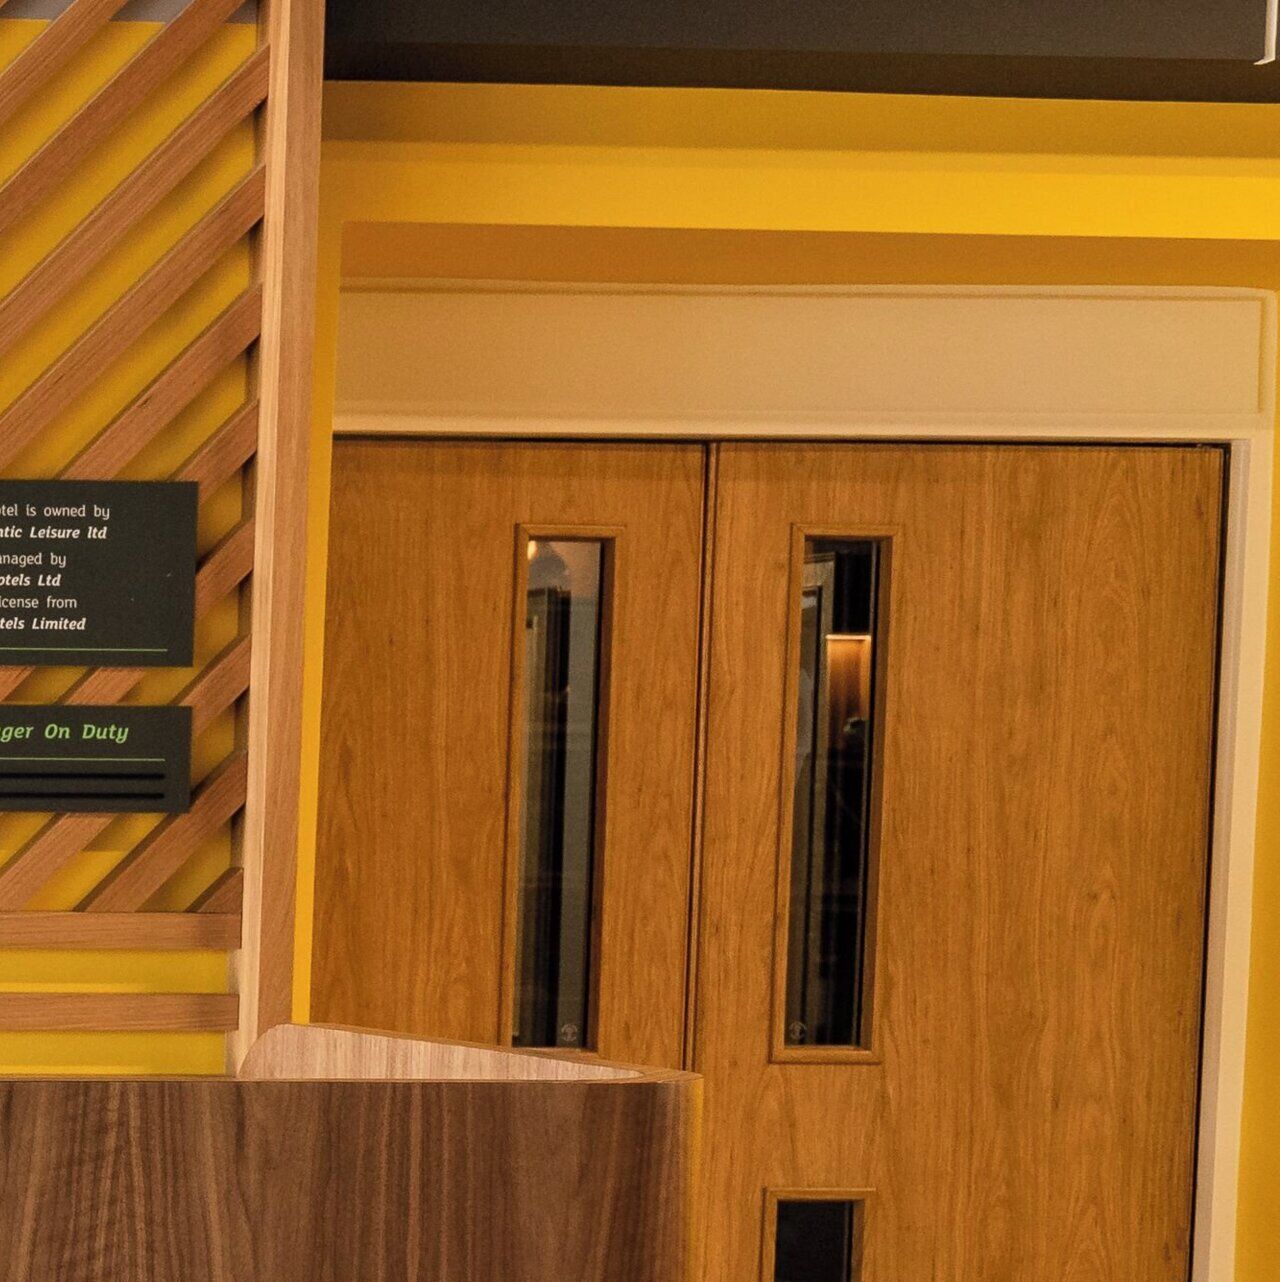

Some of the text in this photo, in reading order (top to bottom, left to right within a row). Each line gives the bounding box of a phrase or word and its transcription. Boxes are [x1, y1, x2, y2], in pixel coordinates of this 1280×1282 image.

[25, 503, 37, 517] is
[43, 504, 86, 518] owned
[93, 504, 110, 521] by
[29, 525, 81, 539] Leisure
[87, 525, 108, 540] ltd
[49, 551, 67, 569] by
[37, 573, 62, 587] Ltd
[46, 595, 78, 609] from
[31, 616, 87, 631] Limited
[44, 723, 71, 740] On
[81, 723, 129, 744] Duty
